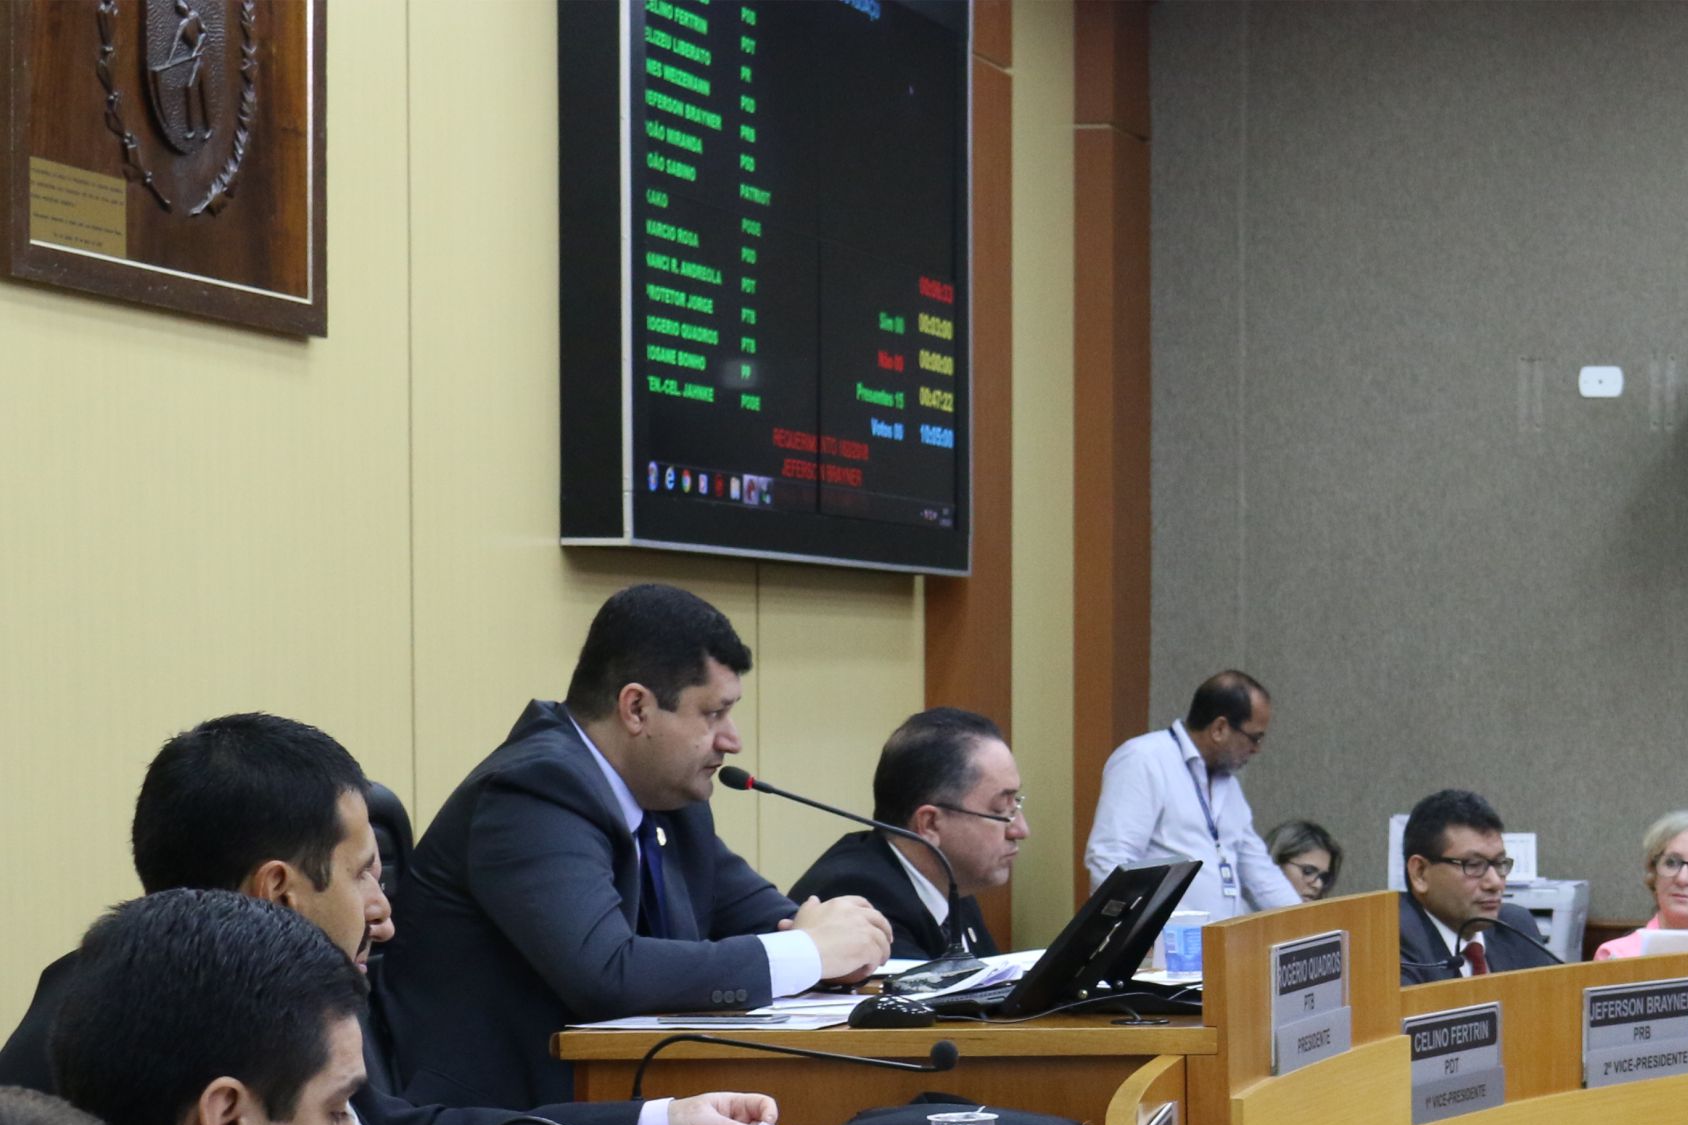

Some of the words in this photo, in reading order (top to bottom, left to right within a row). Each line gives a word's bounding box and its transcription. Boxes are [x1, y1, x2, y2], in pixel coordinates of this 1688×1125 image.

[1308, 951, 1341, 980] QUADROS
[1590, 996, 1645, 1021] JEFERSON
[1413, 1027, 1449, 1053] CELINO
[1450, 1019, 1489, 1046] FERTRIN
[1633, 1025, 1651, 1041] PRB
[1444, 1057, 1459, 1075] PDT
[1613, 1050, 1688, 1074] VICE-PRESIDENTE
